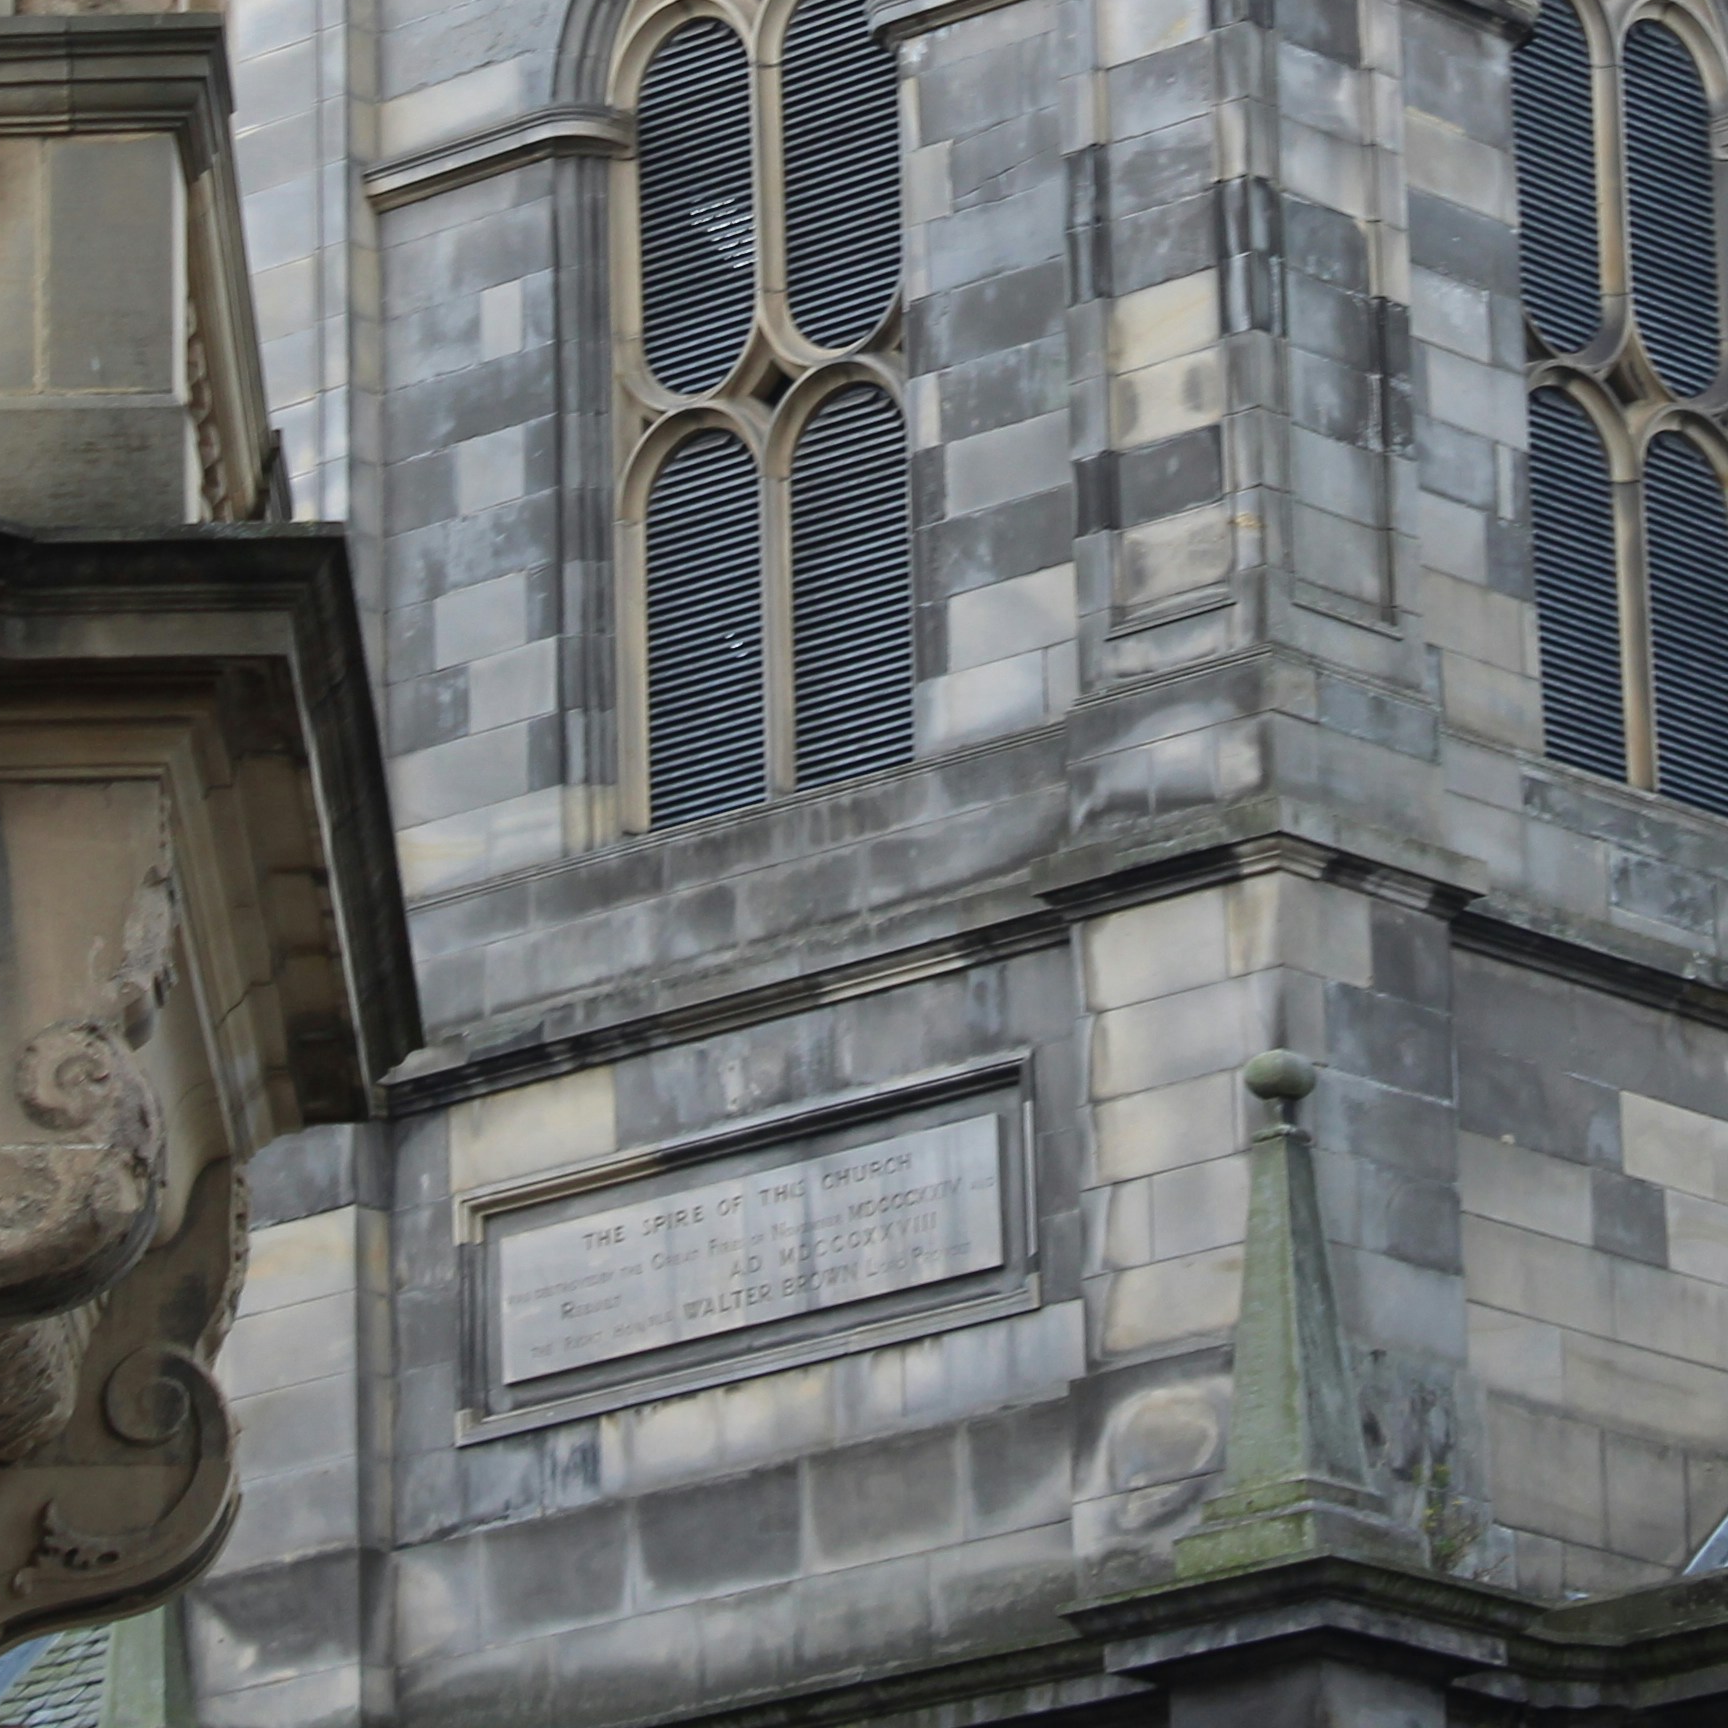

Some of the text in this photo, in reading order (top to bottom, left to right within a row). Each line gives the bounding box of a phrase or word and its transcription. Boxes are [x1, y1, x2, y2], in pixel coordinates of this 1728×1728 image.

[582, 1225, 626, 1251] THE
[641, 1205, 706, 1238] SPIRE
[717, 1195, 744, 1218] OF
[821, 1153, 912, 1191] CHURCH
[682, 1282, 773, 1321] WALTER
[781, 1261, 860, 1299] BROWN
